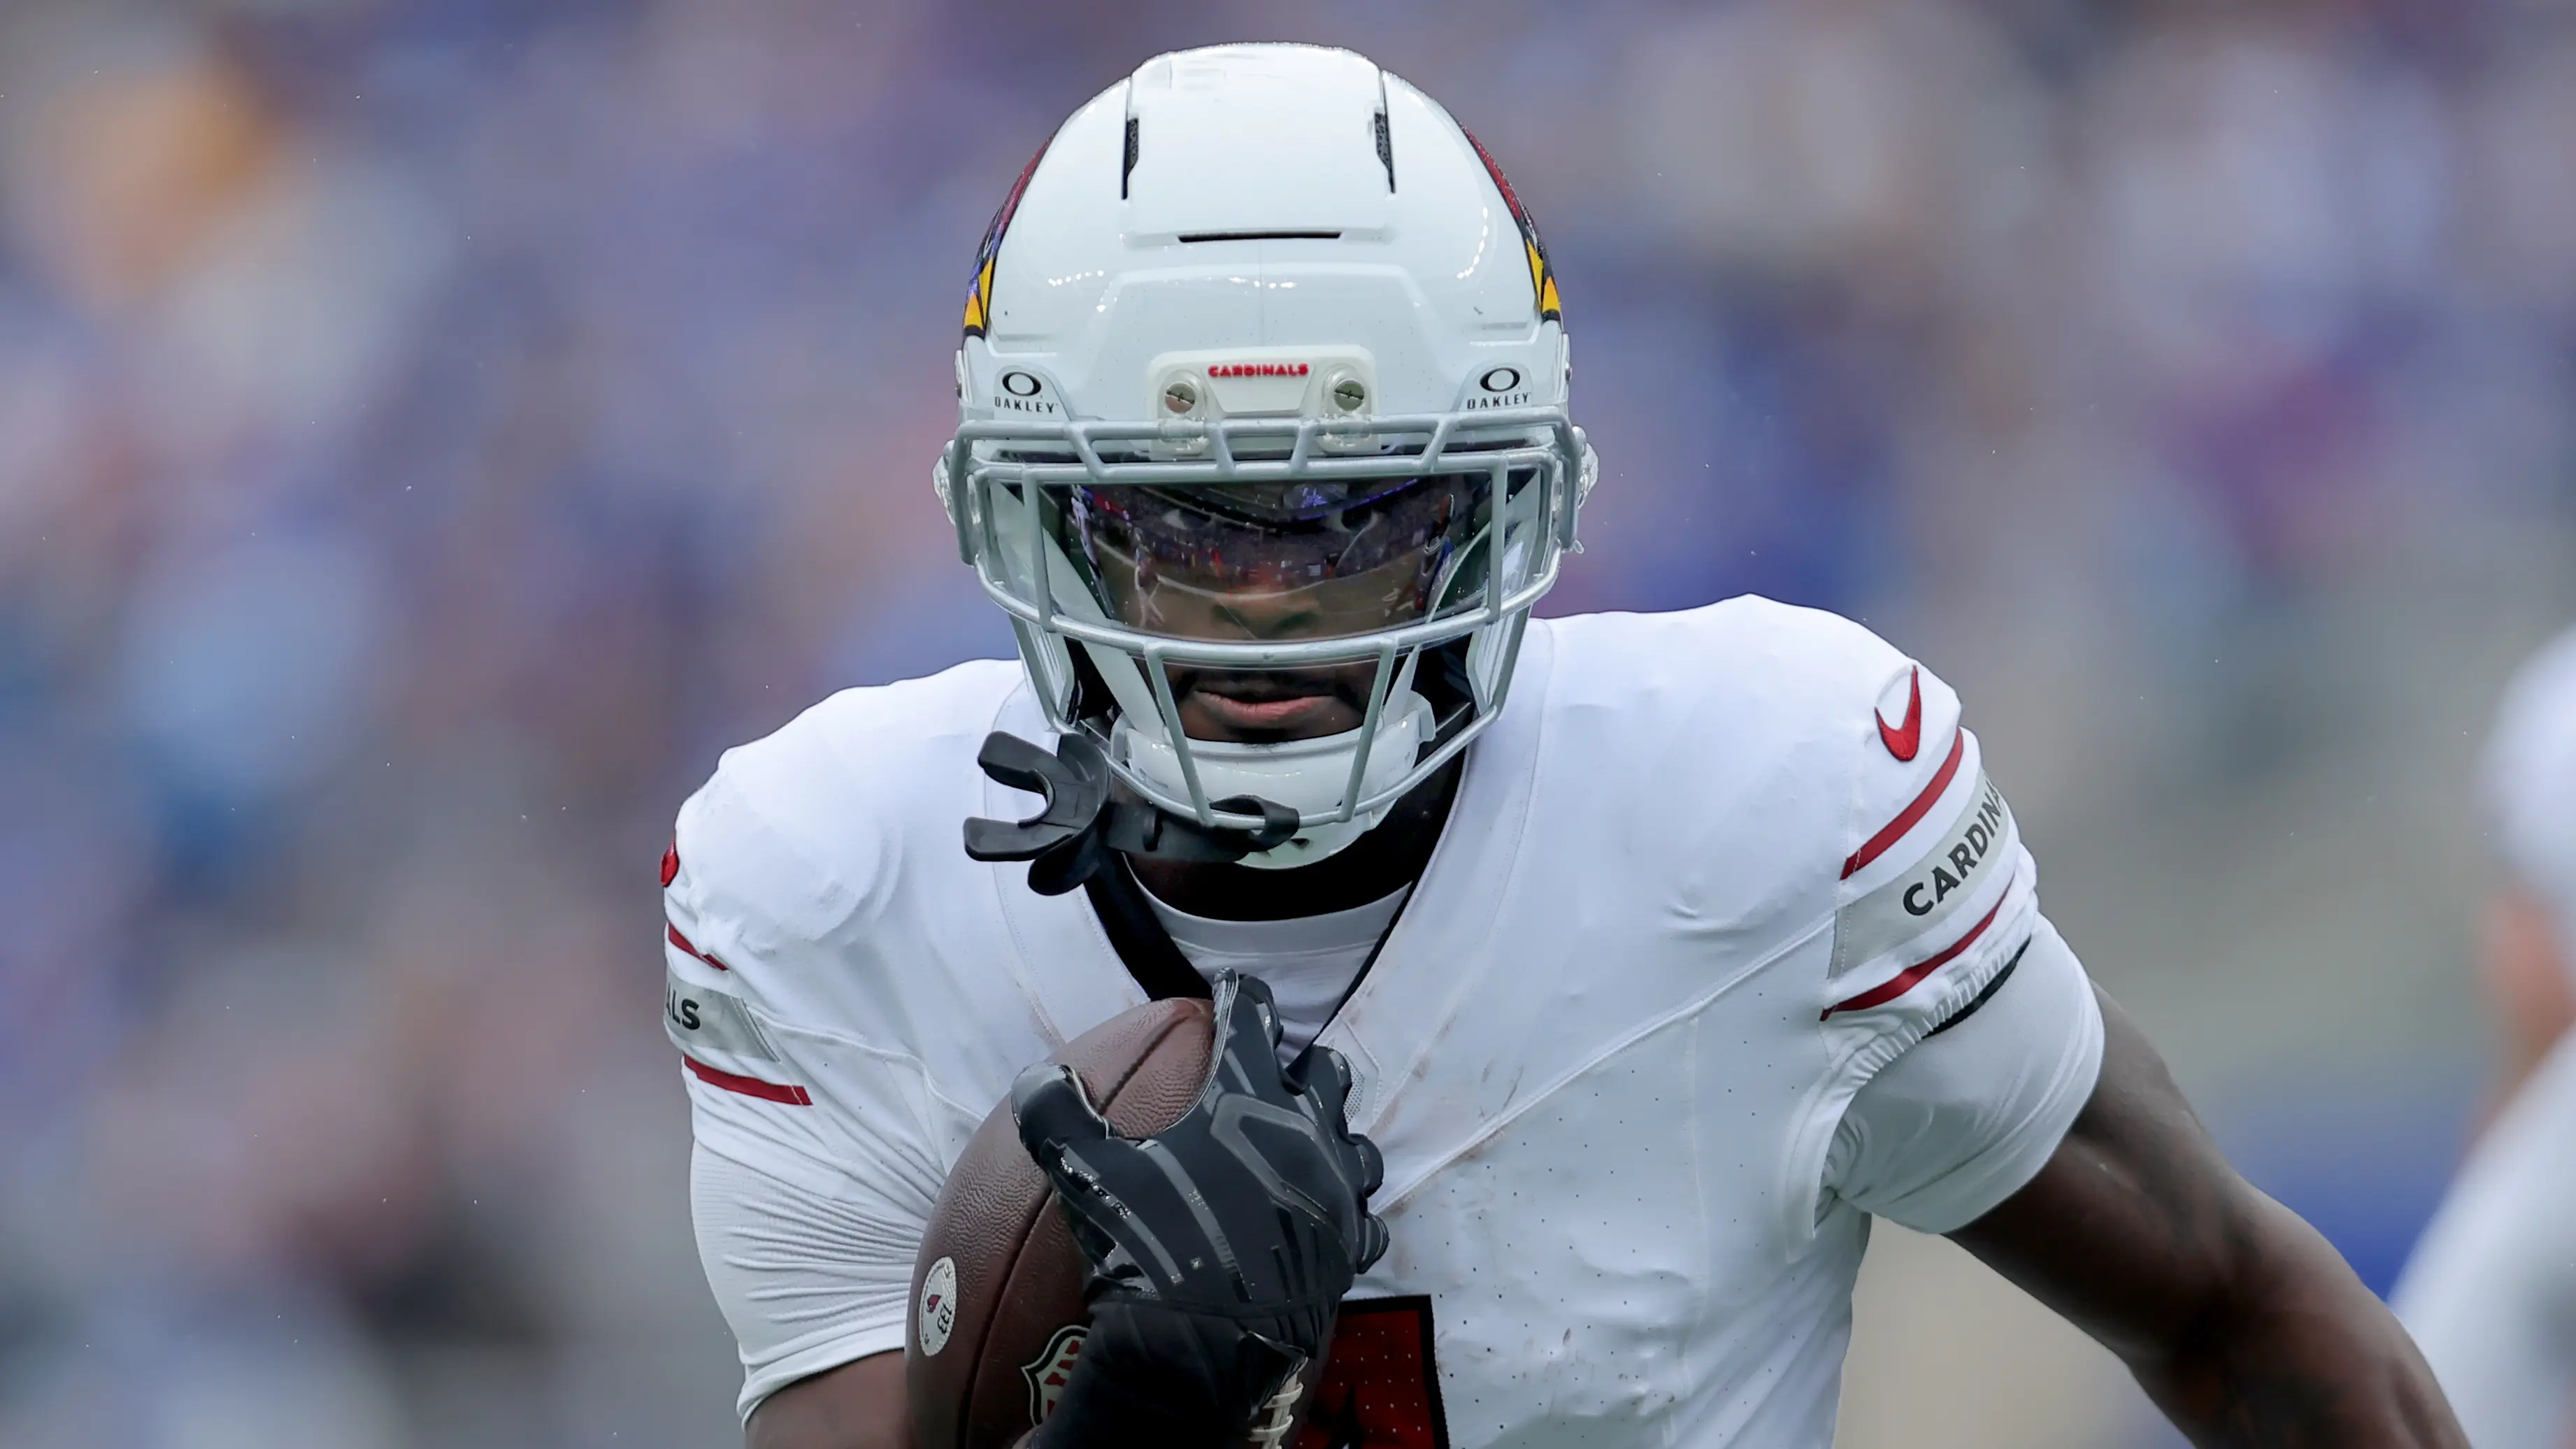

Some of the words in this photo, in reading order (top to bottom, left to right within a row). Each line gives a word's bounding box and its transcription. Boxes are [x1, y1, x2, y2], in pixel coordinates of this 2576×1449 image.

[1208, 362, 1308, 378] CARDINALS
[994, 396, 1054, 413] OAKLEY
[1466, 392, 1529, 410] OAKLEY
